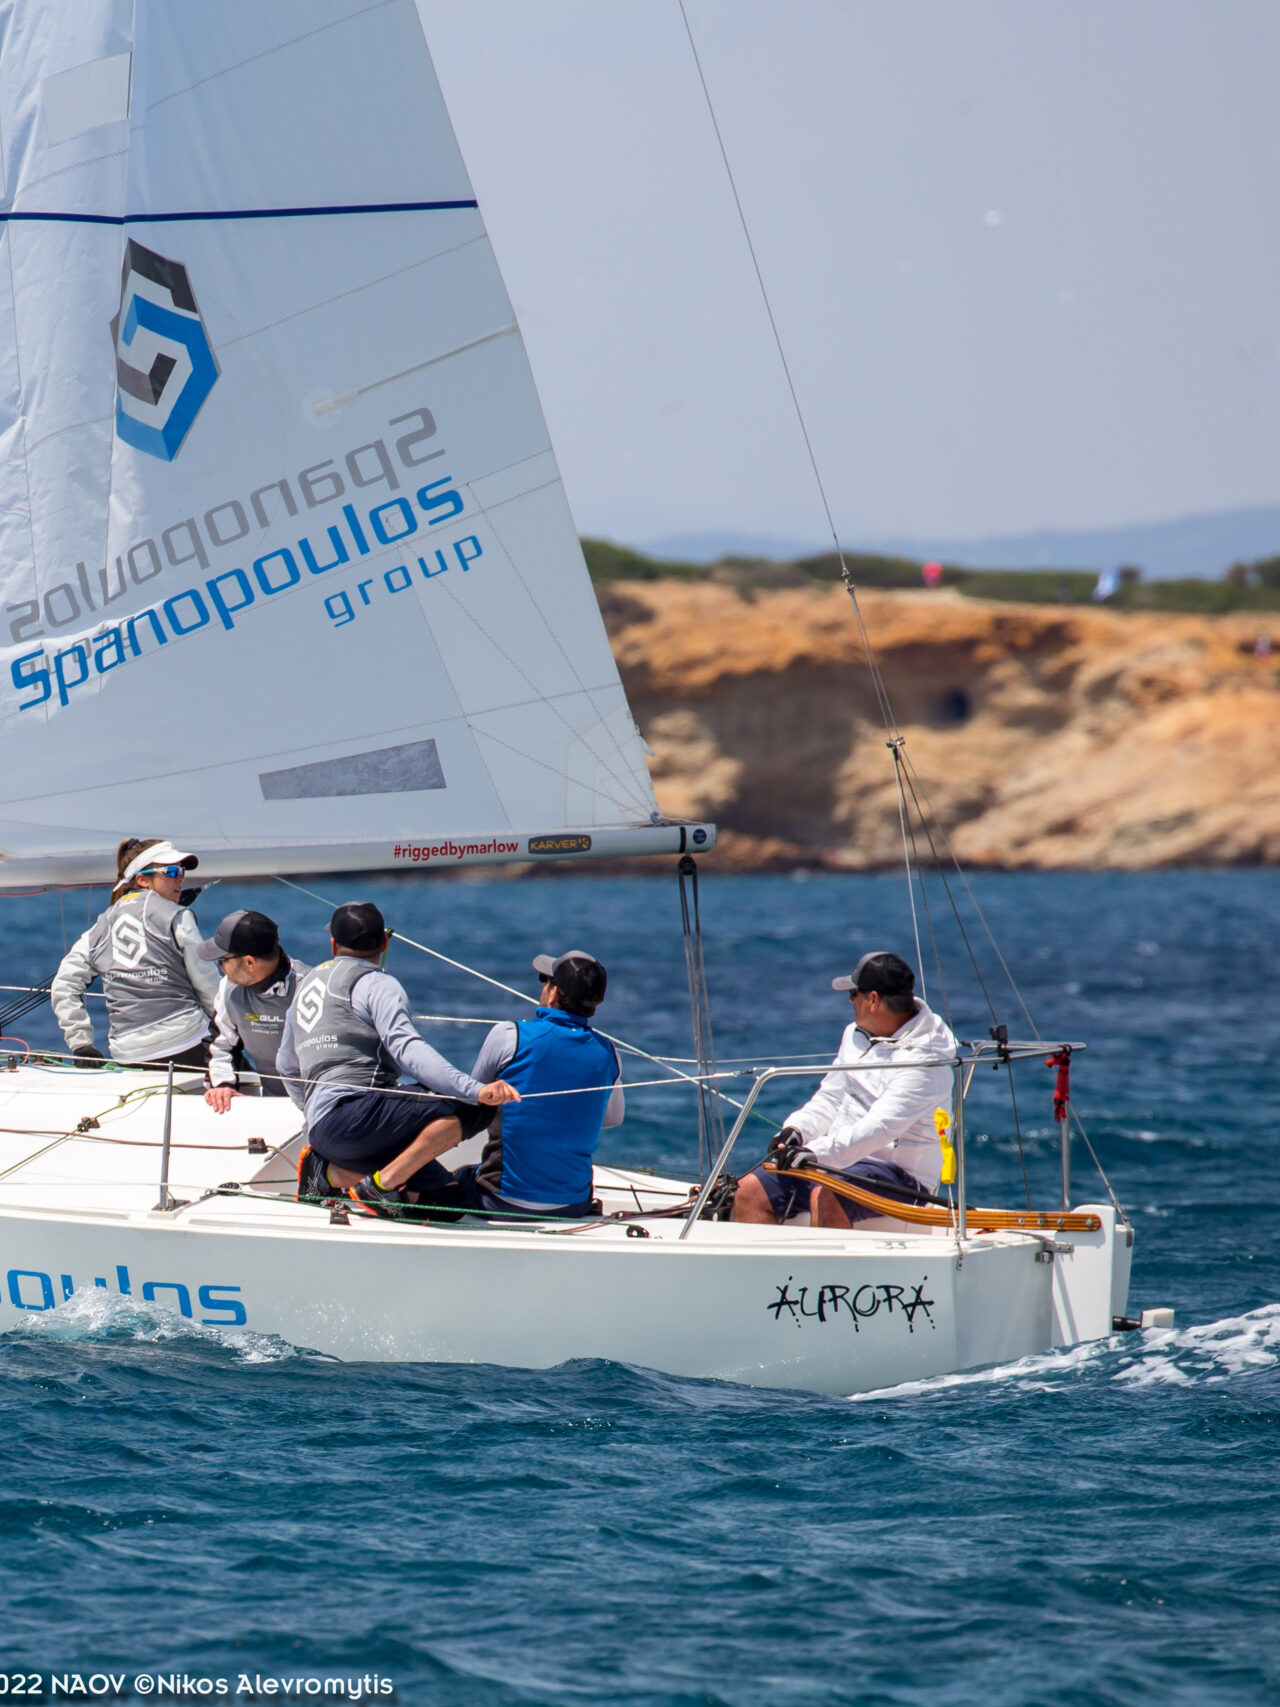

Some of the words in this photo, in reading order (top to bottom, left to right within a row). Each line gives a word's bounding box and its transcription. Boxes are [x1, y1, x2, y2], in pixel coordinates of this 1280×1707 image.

[11, 476, 465, 711] Spanopoulos
[324, 535, 484, 628] group
[394, 839, 519, 861] #riggedbymarlow
[530, 839, 578, 850] KARVER
[259, 1014, 284, 1022] GUL
[767, 1275, 936, 1333] AURORA
